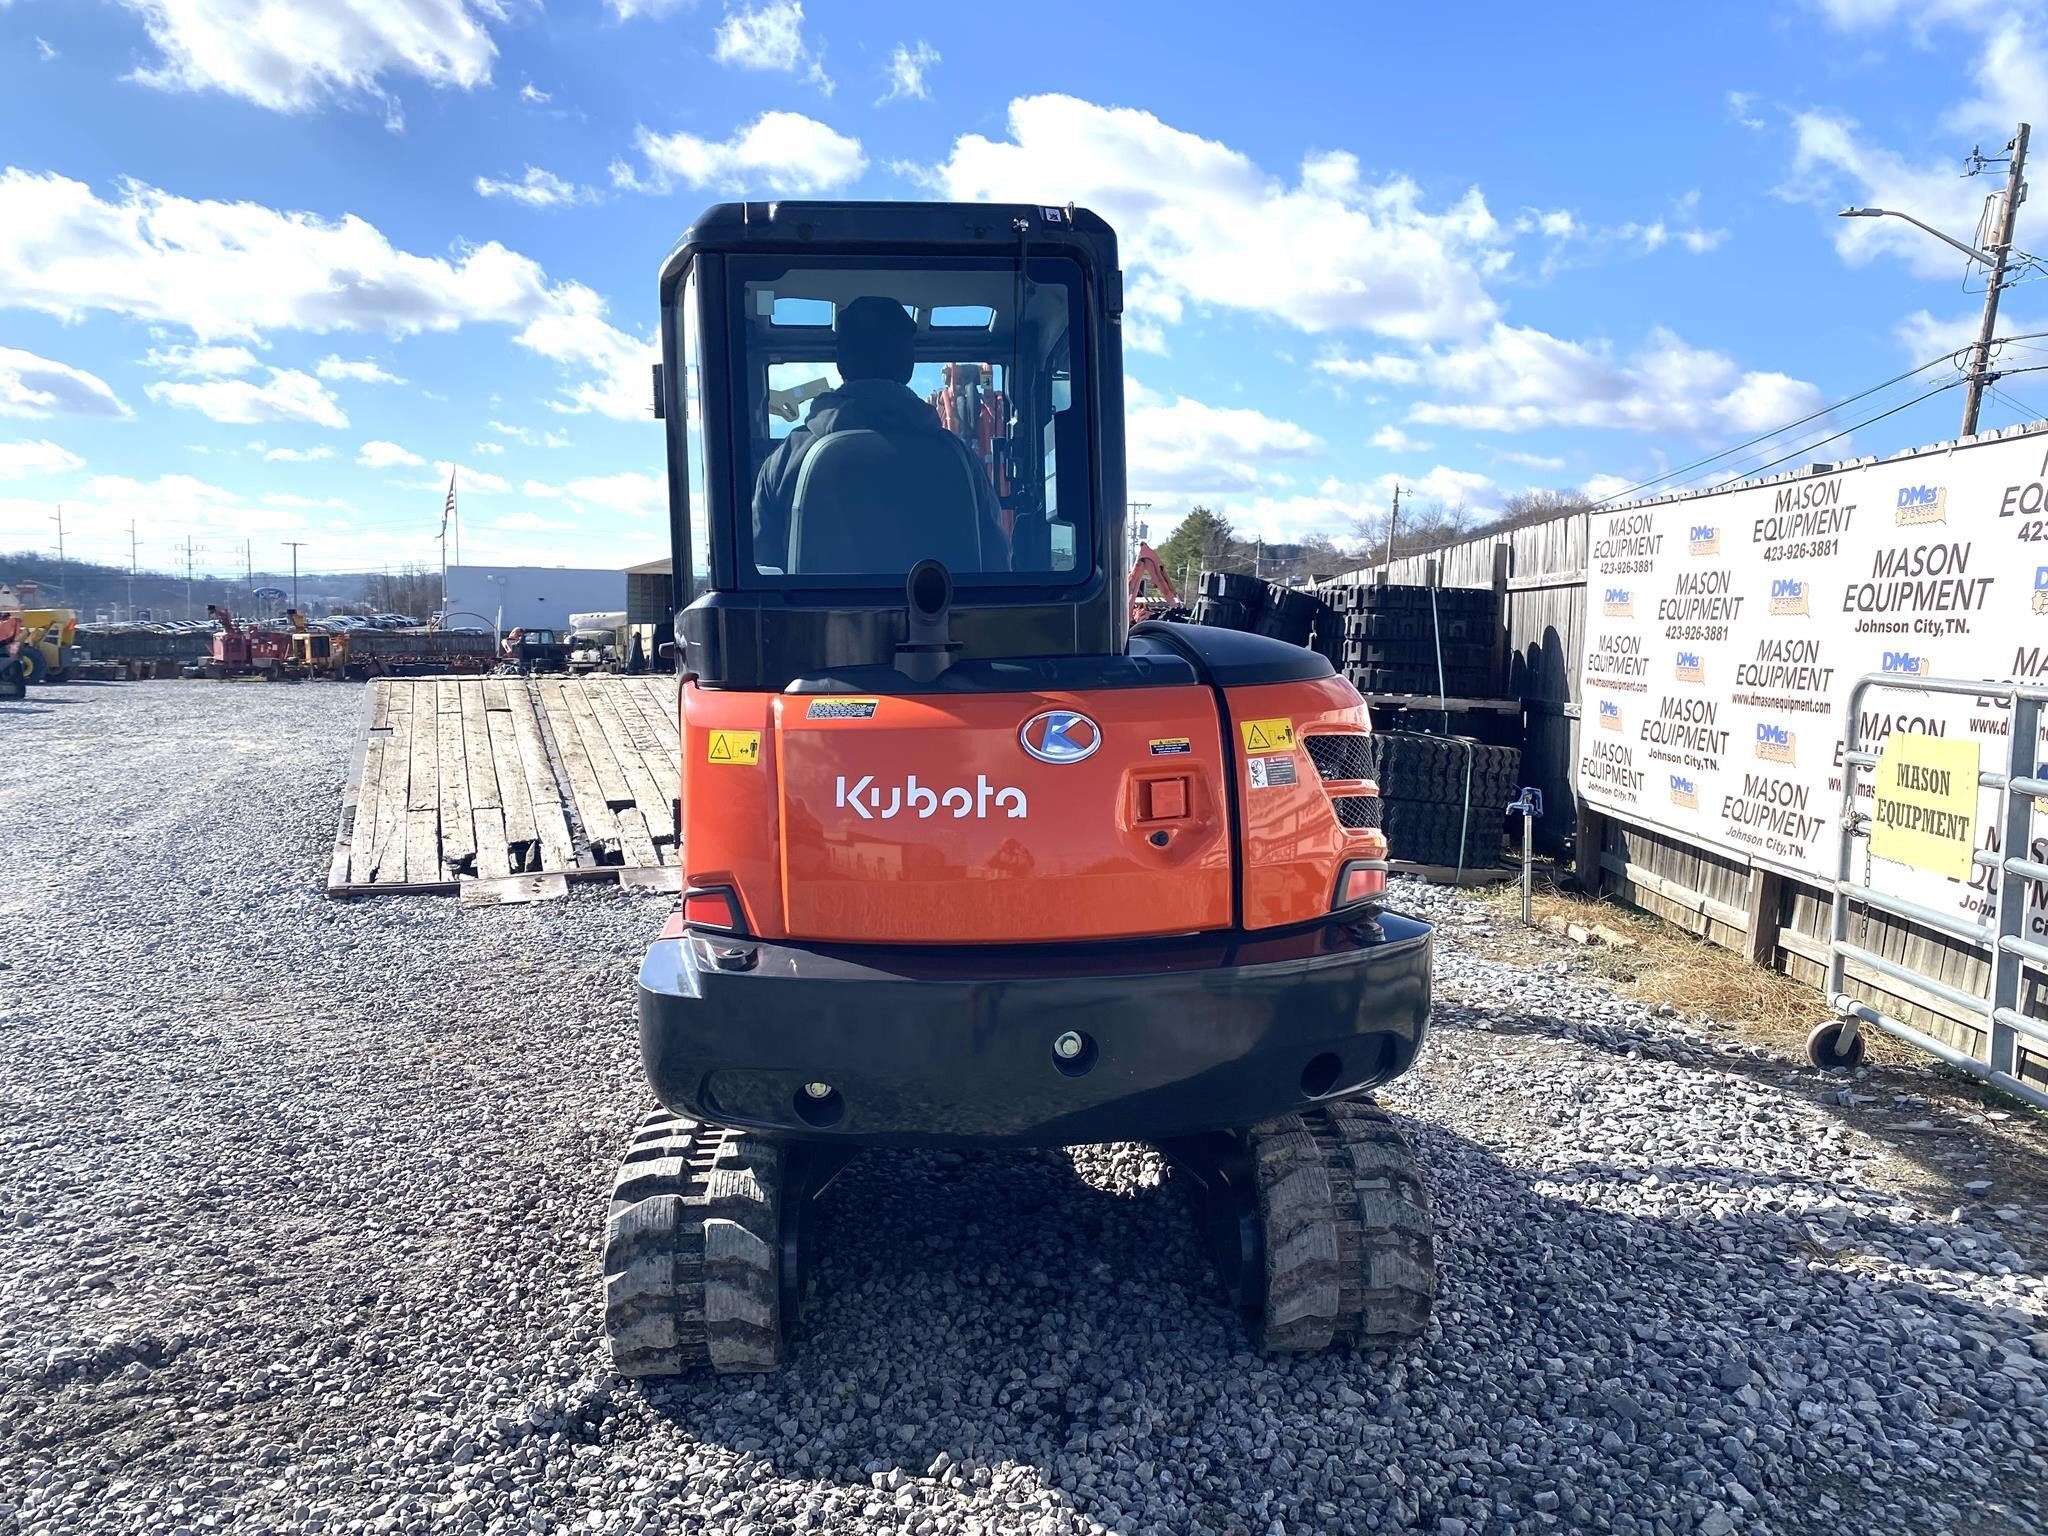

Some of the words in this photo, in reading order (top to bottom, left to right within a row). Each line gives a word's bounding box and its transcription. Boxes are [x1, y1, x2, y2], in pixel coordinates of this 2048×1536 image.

[1774, 478, 1842, 514] MASON
[1609, 513, 1653, 538] MASON
[1752, 504, 1857, 543] EQUIPMENT
[1593, 535, 1663, 558] EQUIPMENT
[1763, 539, 1839, 562] 423-926-3881
[1872, 542, 1971, 579] MASON
[1675, 570, 1731, 595] MASON
[1842, 578, 1995, 612] EQUIPMENT
[1658, 597, 1744, 621] EQUIPMENT
[1665, 625, 1729, 641] 423-926-3881
[1854, 618, 1909, 634] Johnson
[1599, 635, 1641, 655] MASON
[1756, 639, 1820, 664] MASON
[1588, 654, 1649, 676] EQUIPMENT
[1736, 664, 1834, 692] EQUIPMENT
[1660, 696, 1718, 725] MASON
[1731, 692, 1831, 714] www.dmasonequipment.com
[1640, 719, 1730, 755] EQUIPMENT
[1593, 739, 1632, 767] MASON
[1648, 747, 1682, 764] Johnson
[1581, 757, 1645, 791] EQUIPMENT
[1897, 763, 1951, 796] MASON
[836, 774, 1027, 819] Kubota
[1742, 773, 1810, 811] MASON
[1721, 795, 1825, 843] EQUIPMENT
[1877, 798, 1970, 843] EQUIPMENT
[1726, 826, 1763, 846] Johnson
